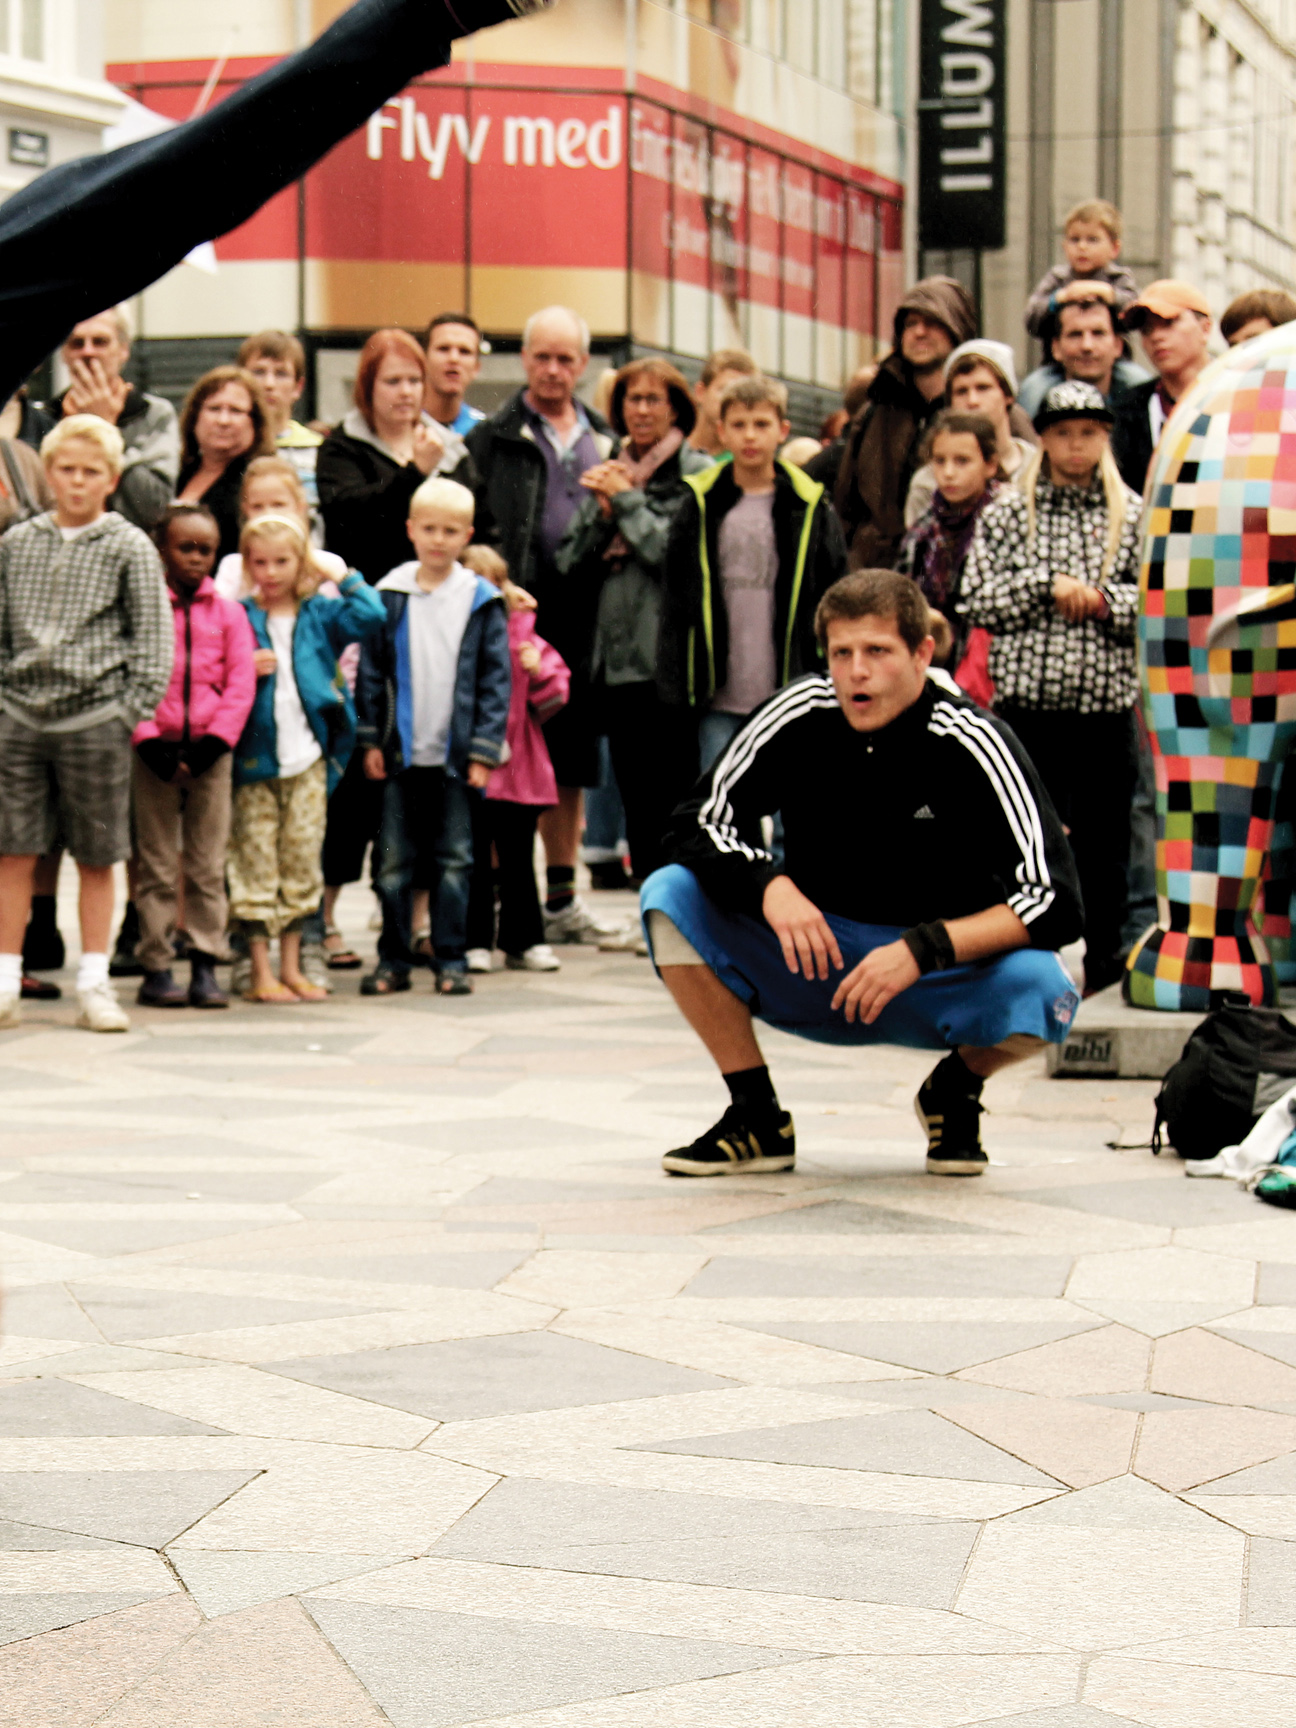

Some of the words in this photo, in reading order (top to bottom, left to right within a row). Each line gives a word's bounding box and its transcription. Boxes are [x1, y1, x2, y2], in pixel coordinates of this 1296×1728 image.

[366, 96, 492, 181] Flyv
[503, 104, 623, 171] med
[939, 0, 995, 192] ILLUM
